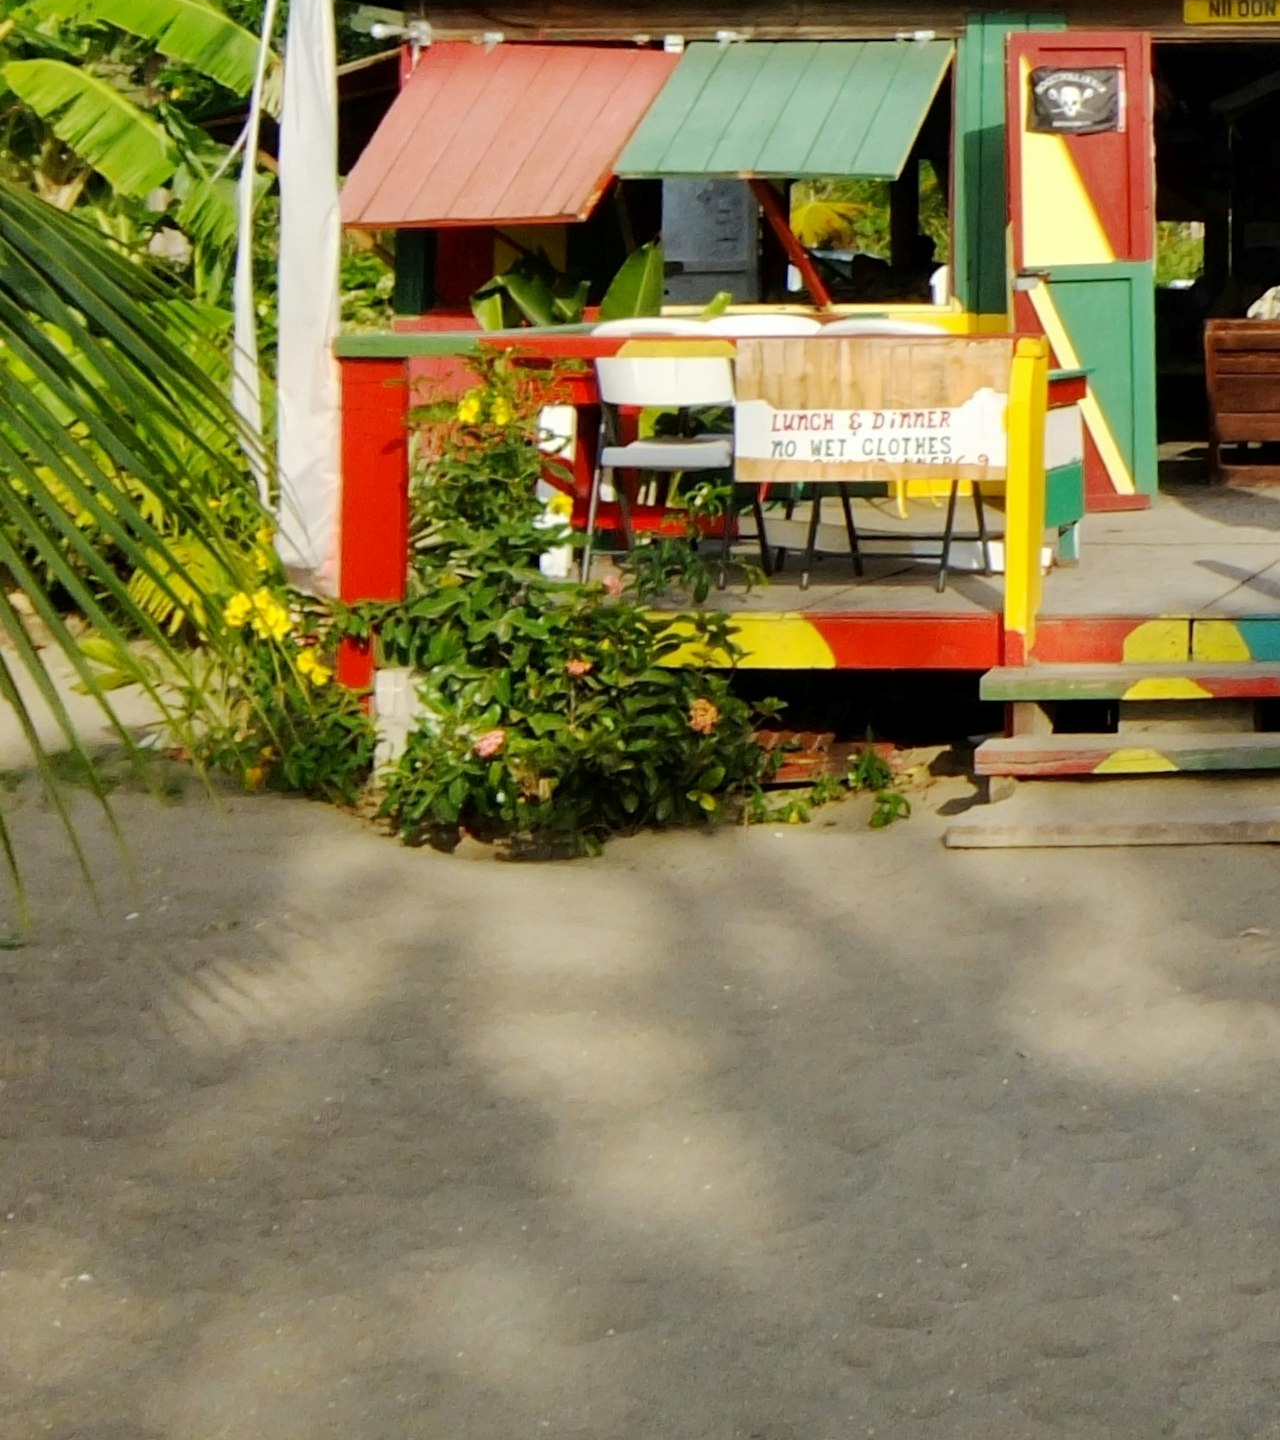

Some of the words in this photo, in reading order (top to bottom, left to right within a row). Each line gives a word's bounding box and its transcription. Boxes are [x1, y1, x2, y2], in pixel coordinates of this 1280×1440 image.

[771, 413, 834, 432] LUNCH
[848, 412, 863, 436] &
[811, 439, 847, 457] WET
[862, 437, 952, 456] CLOTHES
